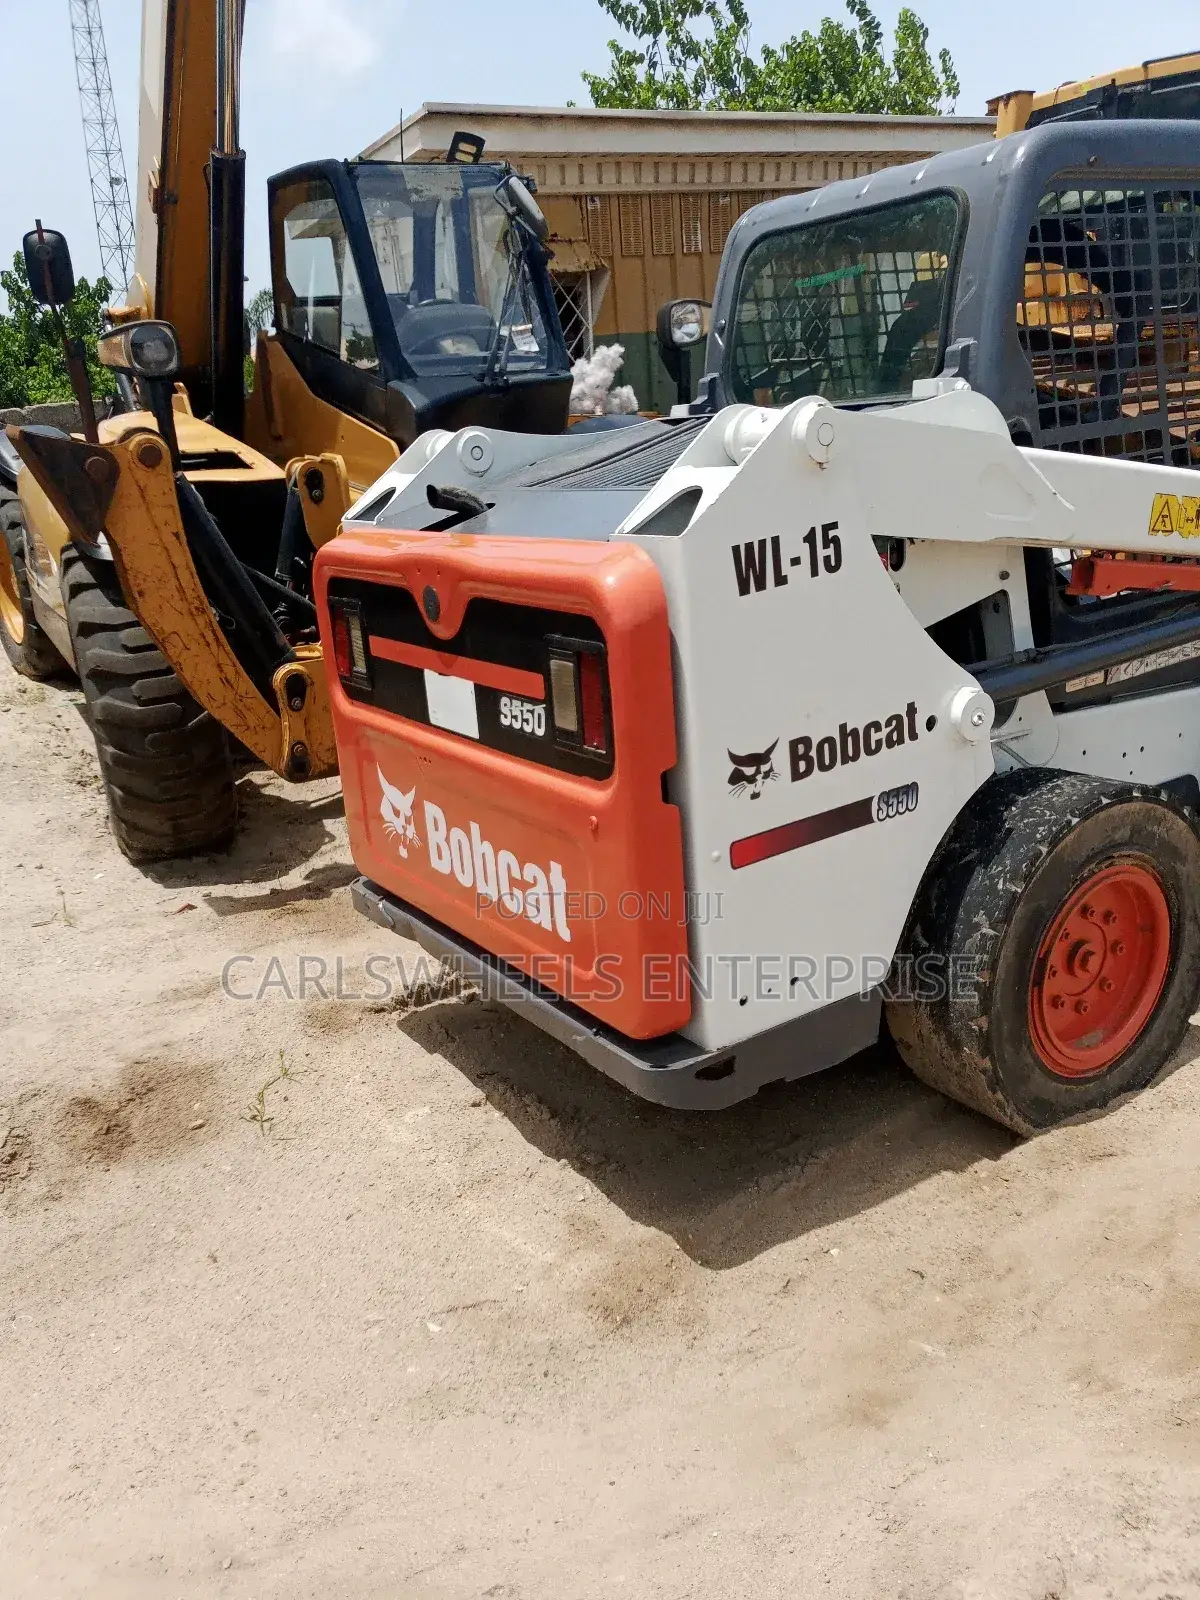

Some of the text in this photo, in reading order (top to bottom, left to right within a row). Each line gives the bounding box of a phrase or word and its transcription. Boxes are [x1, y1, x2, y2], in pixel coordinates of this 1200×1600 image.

[732, 522, 842, 596] WL-15
[500, 697, 546, 736] S550
[789, 702, 918, 782] Bobcat
[877, 781, 919, 822] S550
[425, 800, 571, 942] Bobcat
